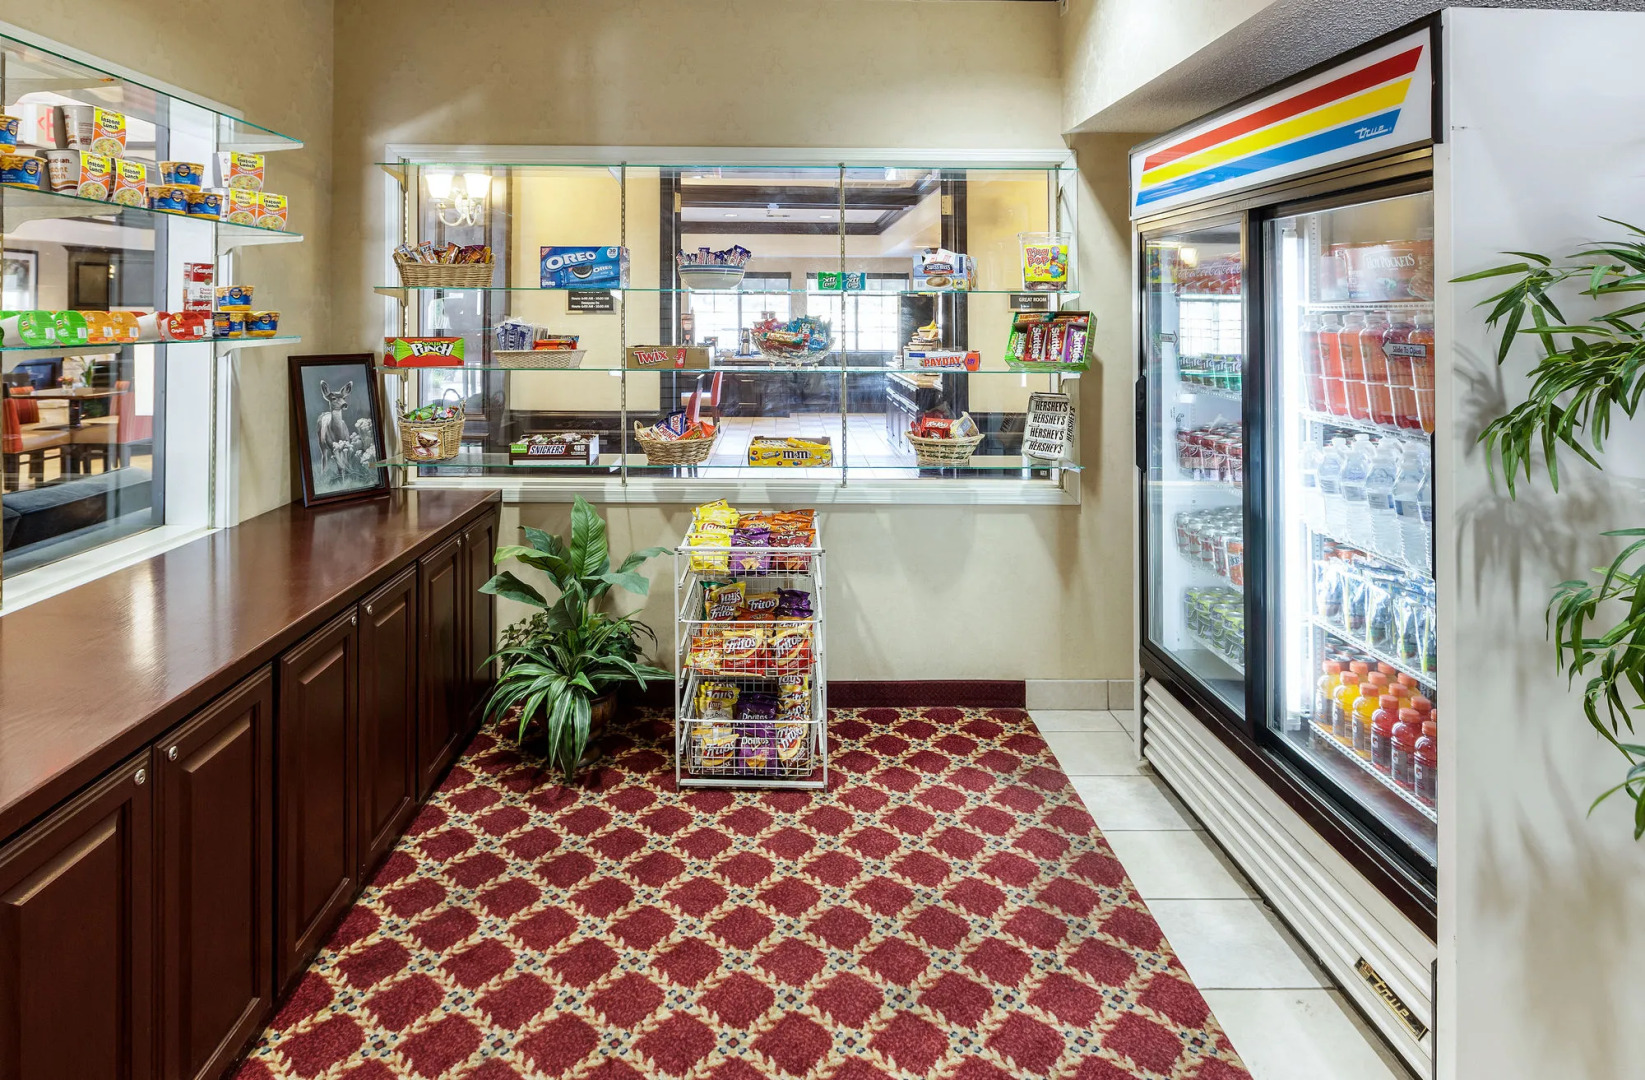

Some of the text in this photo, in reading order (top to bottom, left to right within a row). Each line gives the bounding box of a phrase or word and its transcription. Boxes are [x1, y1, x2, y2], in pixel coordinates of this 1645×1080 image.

[545, 250, 597, 271] OREO
[1380, 252, 1415, 268] POCKETS
[592, 265, 613, 274] OREO
[410, 343, 454, 357] PUNCH
[1032, 327, 1042, 359] Skittles
[1050, 327, 1060, 360] Skittles
[924, 356, 961, 367] PAYDAY
[1035, 400, 1068, 412] HERSHEY'S
[1032, 413, 1066, 426] HERSHEY'S
[1066, 406, 1076, 442] HERSHEY'S
[1030, 428, 1065, 440] HERSHEY'S
[530, 445, 566, 455] SNICKERS
[1028, 442, 1064, 454] HERSHEY'S
[746, 598, 775, 612] Fritos
[726, 637, 756, 654] Fritos
